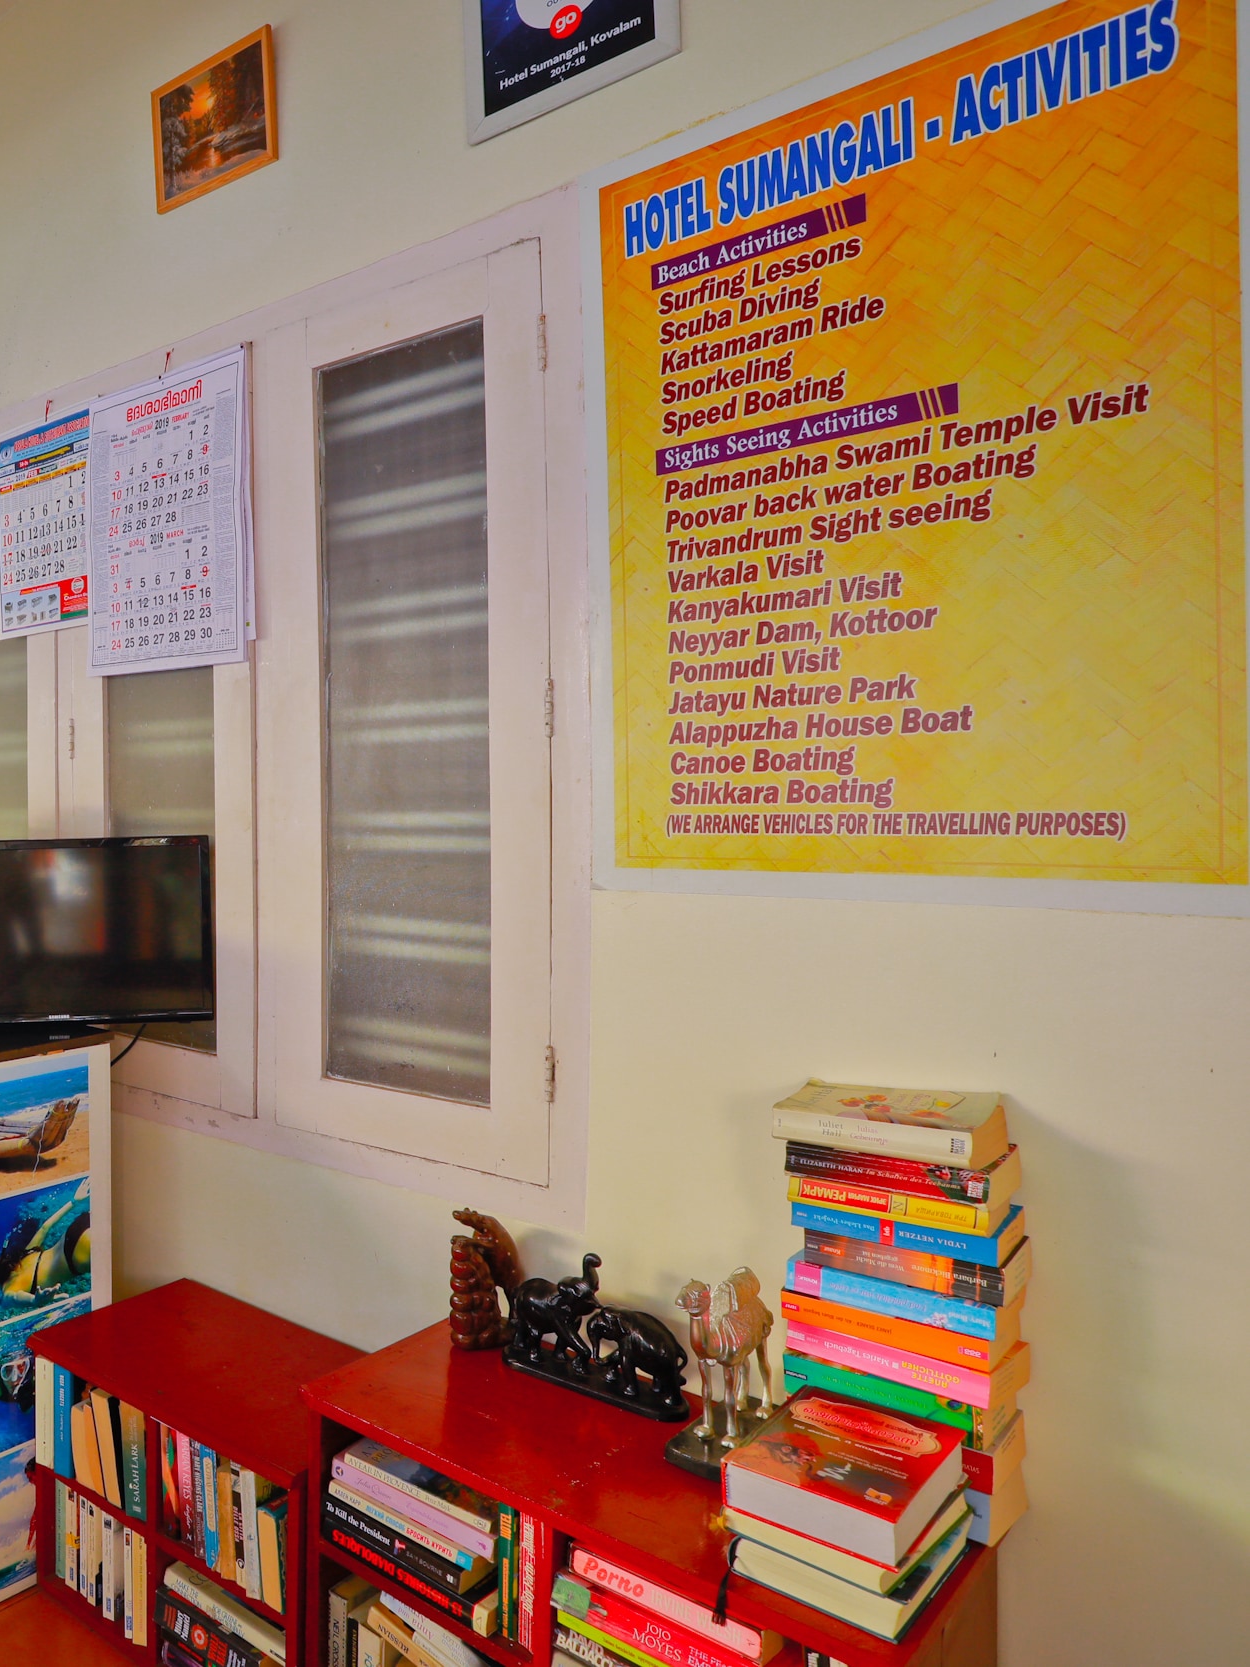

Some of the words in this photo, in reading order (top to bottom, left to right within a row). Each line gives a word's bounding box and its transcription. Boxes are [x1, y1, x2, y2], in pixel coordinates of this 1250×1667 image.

[554, 12, 577, 33] go
[499, 68, 528, 90] Hotel
[530, 40, 589, 76] Sumangali,
[590, 16, 642, 47] Kovalam
[550, 56, 586, 78] 2017-18
[625, 177, 710, 256] HOTEL
[718, 98, 914, 225] SUMANGALI
[952, 0, 1177, 144] ACTIVITIES
[658, 251, 709, 283] Beach
[716, 220, 807, 275] Activities
[658, 273, 745, 316] Surfing
[751, 235, 861, 288] Lessons
[659, 305, 732, 346] Scuba
[739, 278, 820, 325] Diving
[660, 313, 813, 376] Kattamaram
[820, 295, 884, 335] Ride
[660, 351, 793, 405] Snorkeling
[661, 398, 737, 437] Speed
[743, 370, 846, 421] Boating
[155, 417, 169, 430] 2019
[664, 437, 719, 470] Sights
[726, 423, 791, 456] Seeing
[798, 401, 898, 438] Activities
[665, 451, 828, 504] Padmanabha
[835, 433, 929, 469] Swami
[940, 403, 1057, 453] Temple
[1067, 383, 1150, 426] Visit
[111, 490, 122, 502] 10
[126, 487, 134, 497] 11
[138, 482, 149, 493] 12
[154, 478, 165, 489] 13
[169, 474, 180, 485] 14
[184, 470, 195, 480] 15
[199, 465, 209, 476] 16
[666, 501, 748, 535] Poovar
[752, 484, 817, 518] back
[824, 475, 905, 507] water
[912, 445, 1036, 492] Boating
[110, 508, 121, 519] 17
[124, 504, 134, 515] 18
[137, 500, 149, 511] 19
[152, 497, 163, 508] 20
[167, 493, 178, 504] 21
[182, 489, 193, 500] 22
[197, 484, 209, 495] 23
[150, 532, 164, 545] 2019
[166, 529, 184, 539] MARCH
[666, 522, 802, 564] Trivandrum
[809, 506, 881, 546] Sight
[888, 489, 992, 536] seeing
[667, 561, 758, 594] Varkala
[765, 550, 824, 580] Visit
[667, 583, 831, 625] Kanyakumari
[840, 571, 902, 602] Visit
[668, 627, 749, 659] Neyyar
[756, 618, 823, 649] Dam,
[829, 604, 937, 639] Kottoor
[669, 654, 774, 685] Ponmudi
[781, 646, 841, 675] Visit
[668, 689, 746, 719] Jatayu
[752, 681, 841, 710] Nature
[849, 674, 917, 703] Park
[669, 719, 798, 750] Alappuzha
[805, 712, 893, 740] House
[900, 705, 973, 735] Boat
[670, 751, 746, 776] Canoe
[752, 745, 855, 778] Boating
[670, 782, 780, 807] Shikkara
[786, 777, 893, 810] Boating
[666, 814, 692, 838] (WE
[694, 813, 760, 837] ARRANGE
[763, 813, 833, 837] VEHICLES
[836, 813, 868, 837] FOR
[872, 813, 903, 837] THE
[906, 812, 1011, 837] TRAVELLING
[1015, 811, 1128, 841] PURPOSES)
[799, 1158, 836, 1170] ELIZABETH
[838, 1163, 863, 1174] HARAN
[802, 1183, 847, 1202] РЕМАРК
[898, 1230, 934, 1243] NETZER
[937, 1238, 967, 1250] LYDIA
[911, 1264, 952, 1280] Bickmore
[953, 1272, 987, 1288] Barbara
[823, 1340, 862, 1359] Tagebuch
[862, 1351, 890, 1368] Maries
[911, 1371, 949, 1389] ANETTE
[130, 1443, 139, 1469] LARK
[131, 1469, 141, 1503] SARAH
[382, 1473, 421, 1498] PROVENCE
[326, 1501, 335, 1514] To
[335, 1506, 347, 1521] Kill
[348, 1513, 359, 1527] the
[360, 1520, 391, 1546] President
[500, 1512, 512, 1540] HOTEL
[331, 1528, 396, 1576] DIABOLIQUES
[406, 1527, 431, 1546] БРОСИТЬ
[431, 1541, 453, 1558] КУРИТЬ
[583, 1557, 645, 1598] Porno
[651, 1590, 692, 1620] IRVINE
[332, 1618, 340, 1637] NEIL
[377, 1623, 410, 1654] RUSSIAN
[645, 1622, 671, 1642] JOJO
[632, 1628, 682, 1663] MOYES
